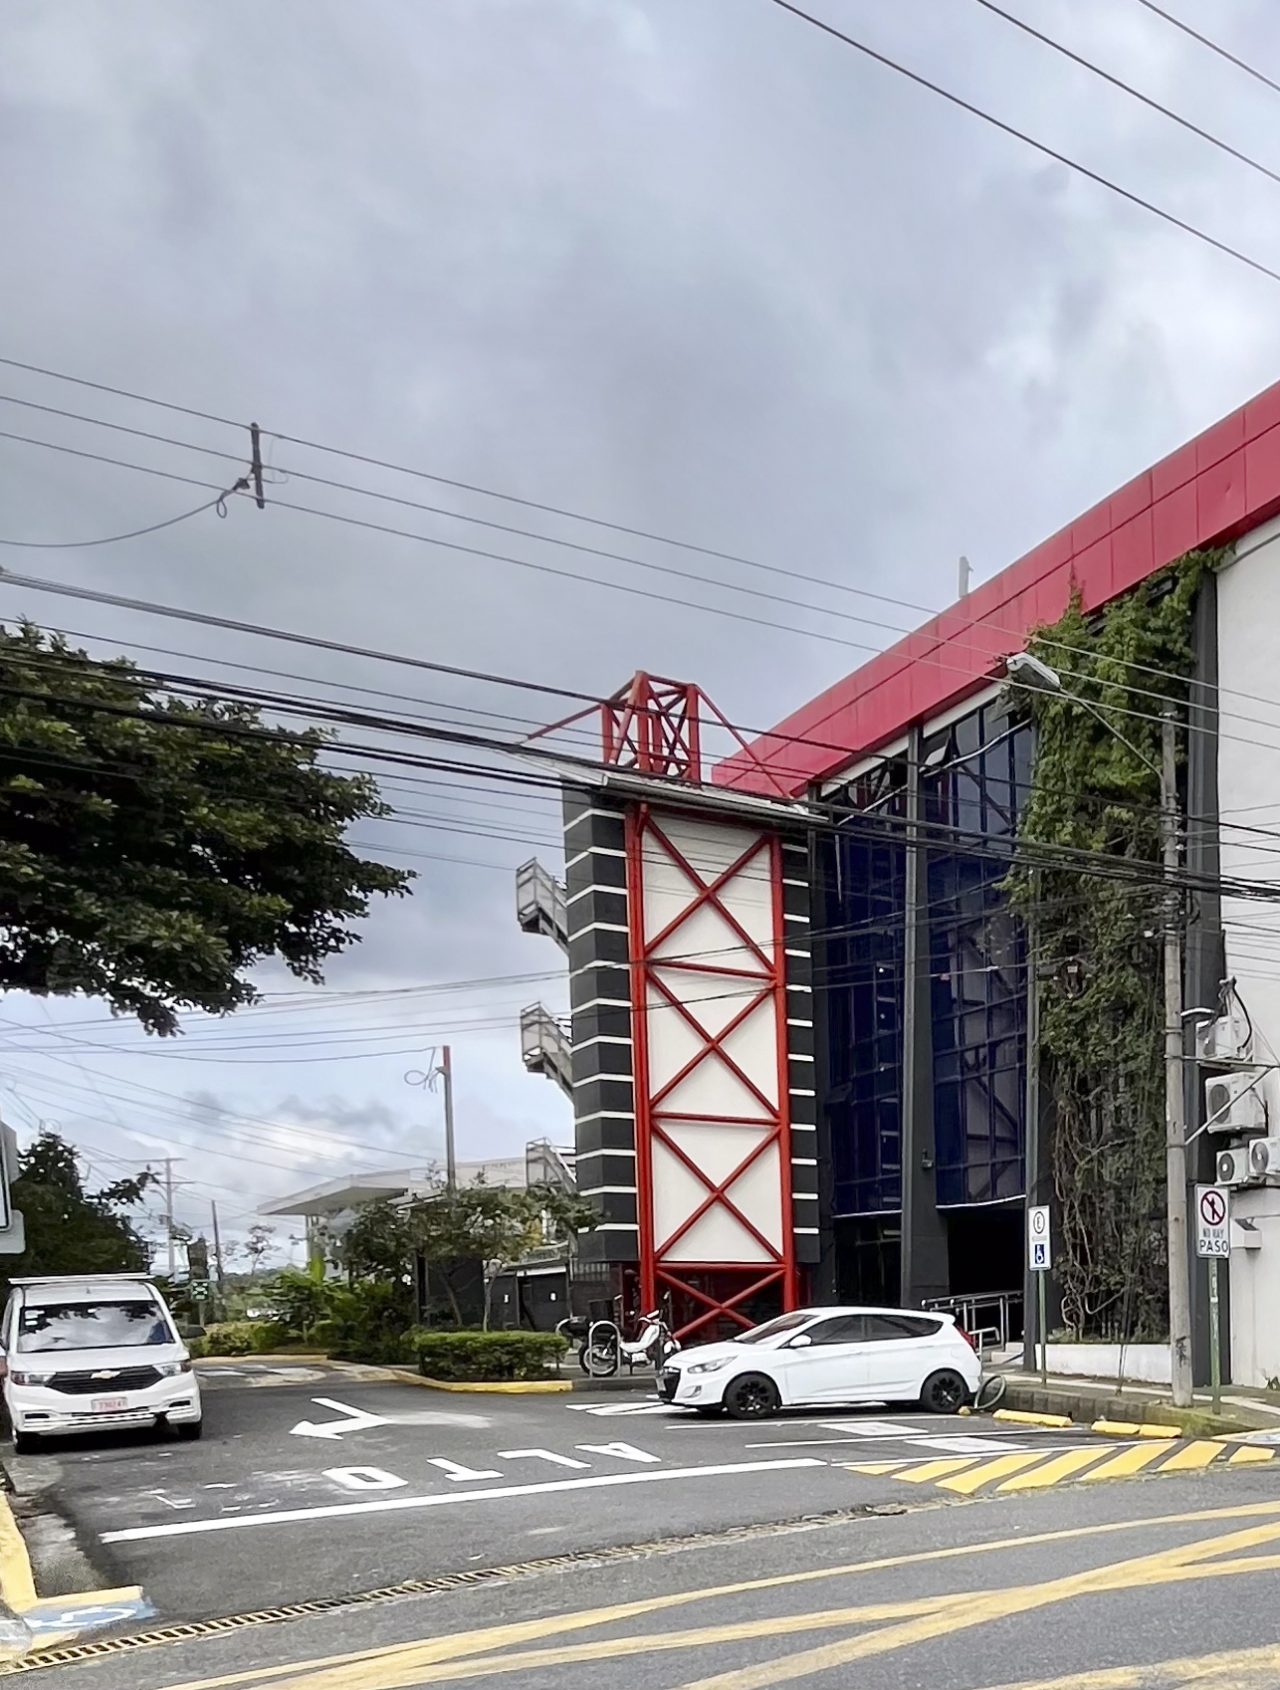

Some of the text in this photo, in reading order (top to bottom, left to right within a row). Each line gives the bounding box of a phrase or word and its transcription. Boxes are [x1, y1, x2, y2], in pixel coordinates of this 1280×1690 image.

[1203, 1228, 1211, 1238] NO
[1200, 1239, 1229, 1253] PASO
[321, 1441, 662, 1491] ALTO
